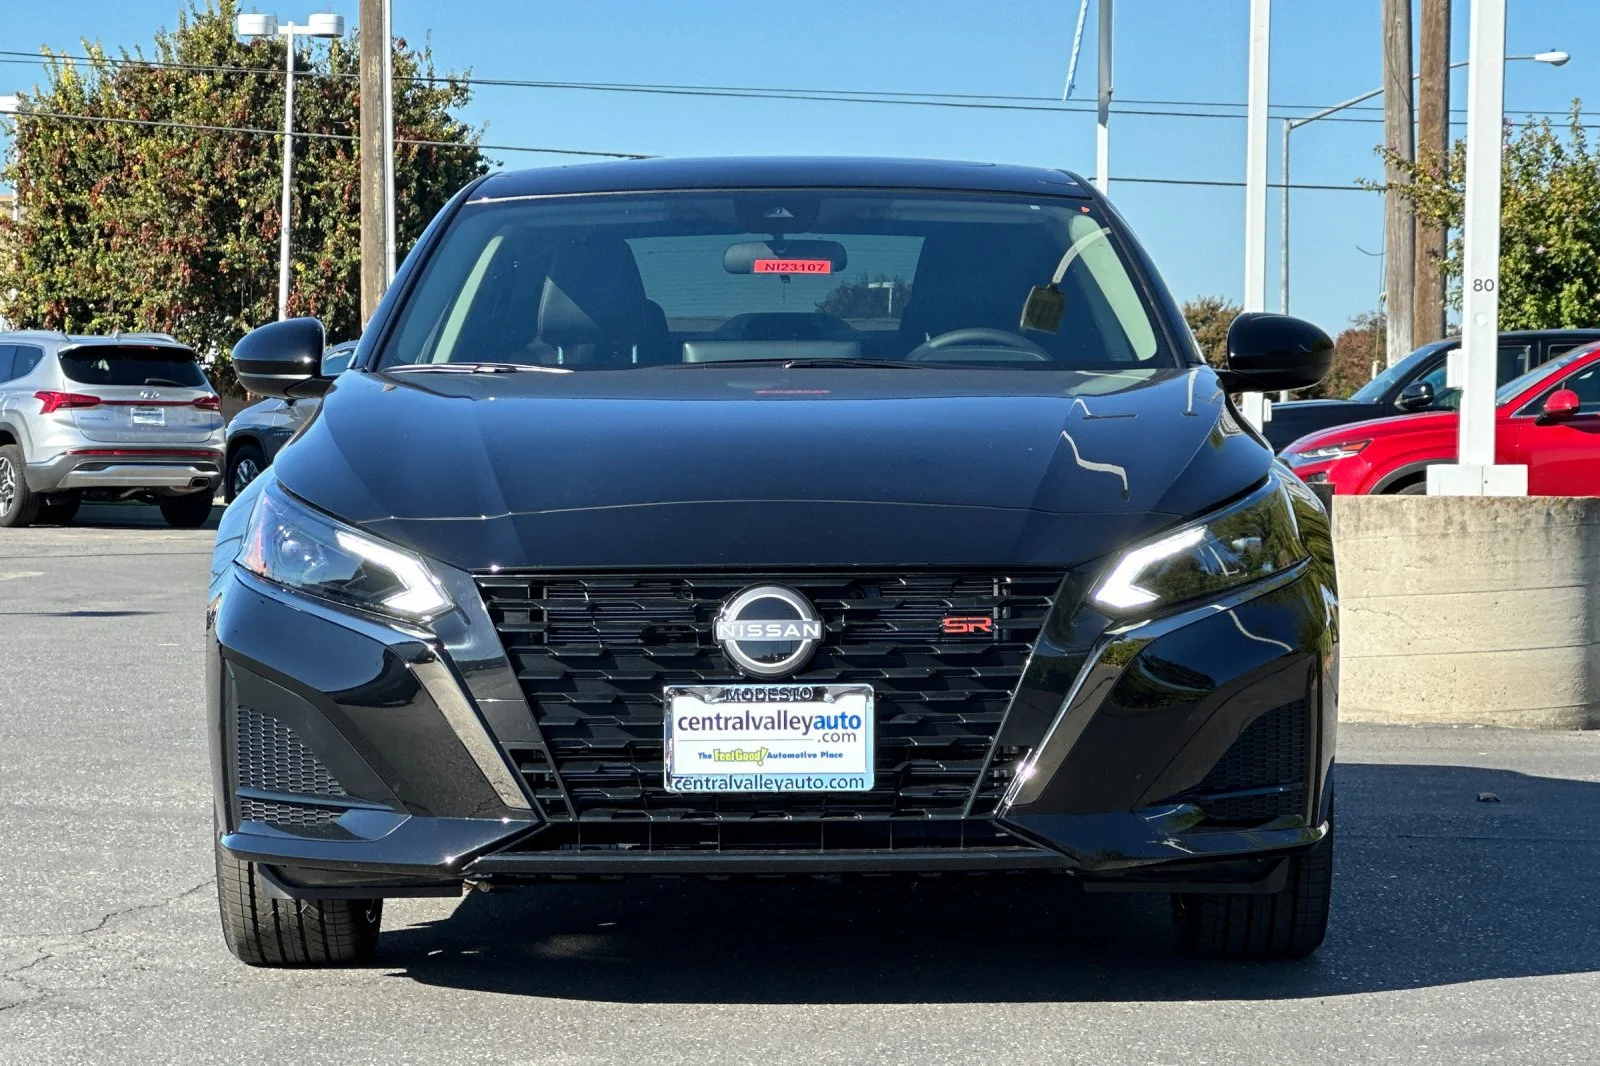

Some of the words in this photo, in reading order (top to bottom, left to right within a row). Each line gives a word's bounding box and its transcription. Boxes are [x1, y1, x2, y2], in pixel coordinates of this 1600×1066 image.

[764, 262, 825, 272] NI23107
[1473, 278, 1495, 292] 80
[717, 622, 819, 638] NISSAN
[943, 616, 993, 633] SR
[725, 687, 813, 701] MODESTO
[698, 752, 713, 760] The
[767, 751, 817, 759] Automotive
[820, 751, 844, 759] Place
[675, 774, 864, 791] centralvalleyauto.com
